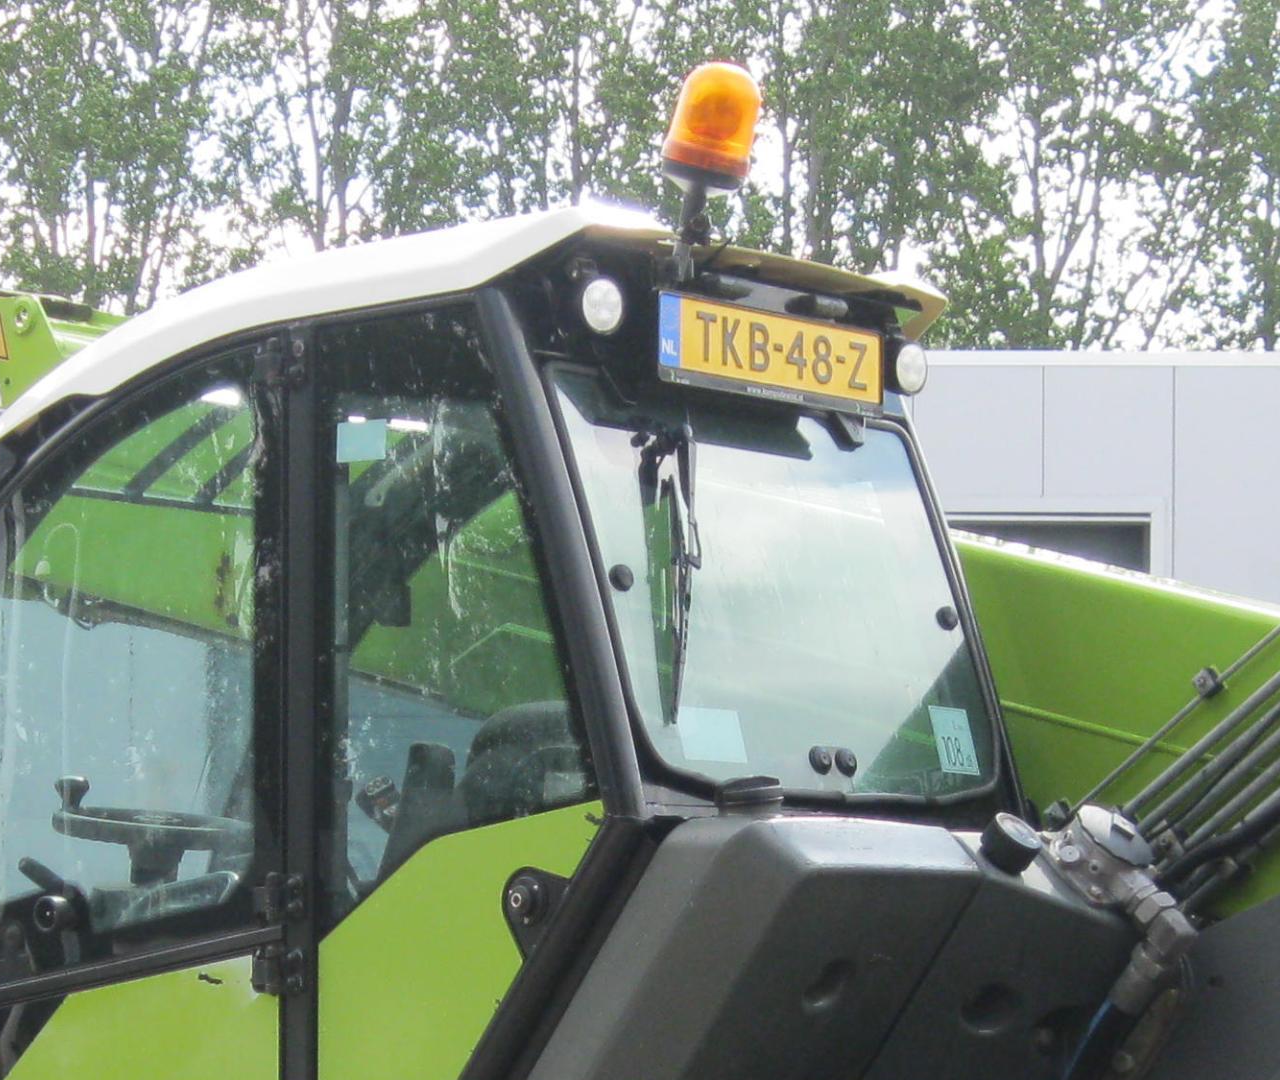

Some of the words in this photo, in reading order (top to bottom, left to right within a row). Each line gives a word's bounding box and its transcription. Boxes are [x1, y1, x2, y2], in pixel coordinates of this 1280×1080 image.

[662, 337, 677, 356] NL
[697, 310, 868, 391] TKB-48-Z
[941, 736, 964, 766] 108
